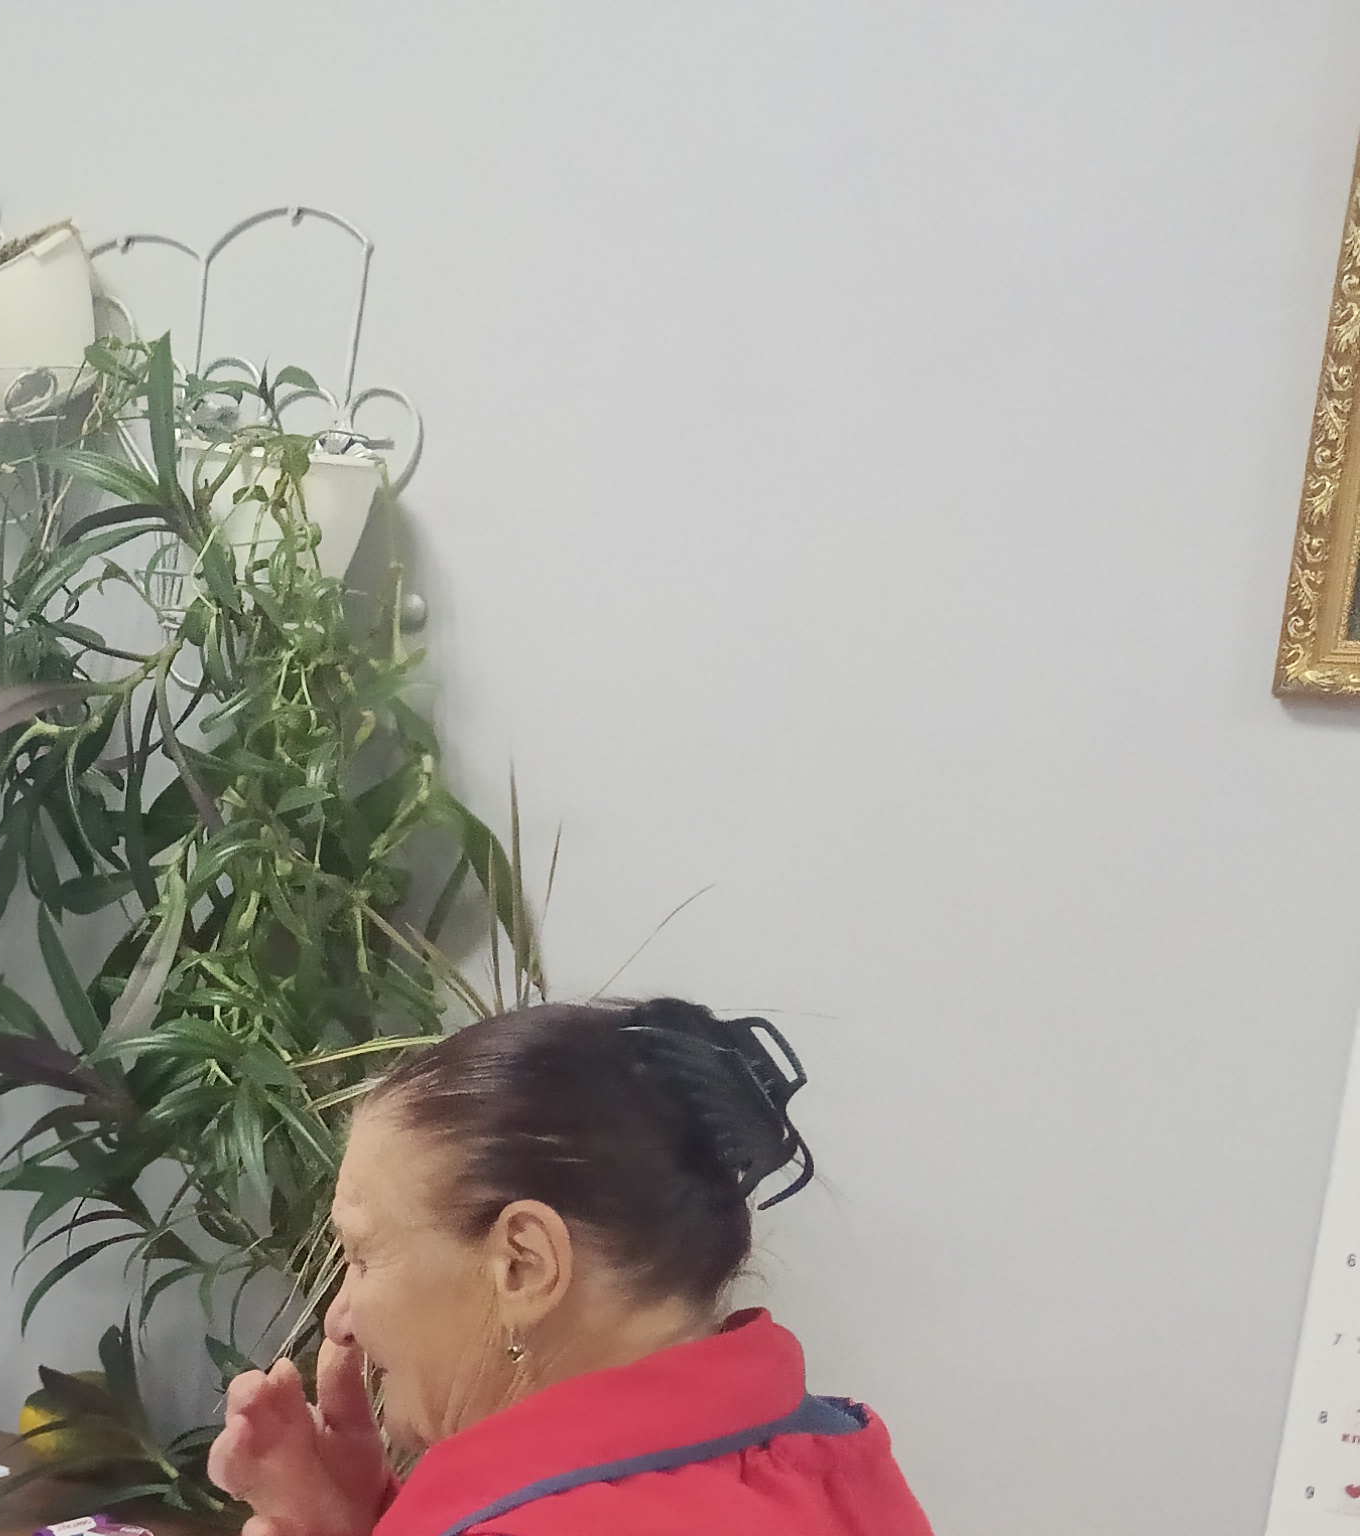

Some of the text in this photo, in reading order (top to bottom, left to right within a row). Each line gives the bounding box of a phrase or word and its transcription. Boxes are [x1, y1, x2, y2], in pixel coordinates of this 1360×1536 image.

[1347, 1253, 1357, 1267] 6
[1333, 1333, 1343, 1346] 7
[1318, 1410, 1328, 1424] 8
[1305, 1485, 1315, 1499] 9
